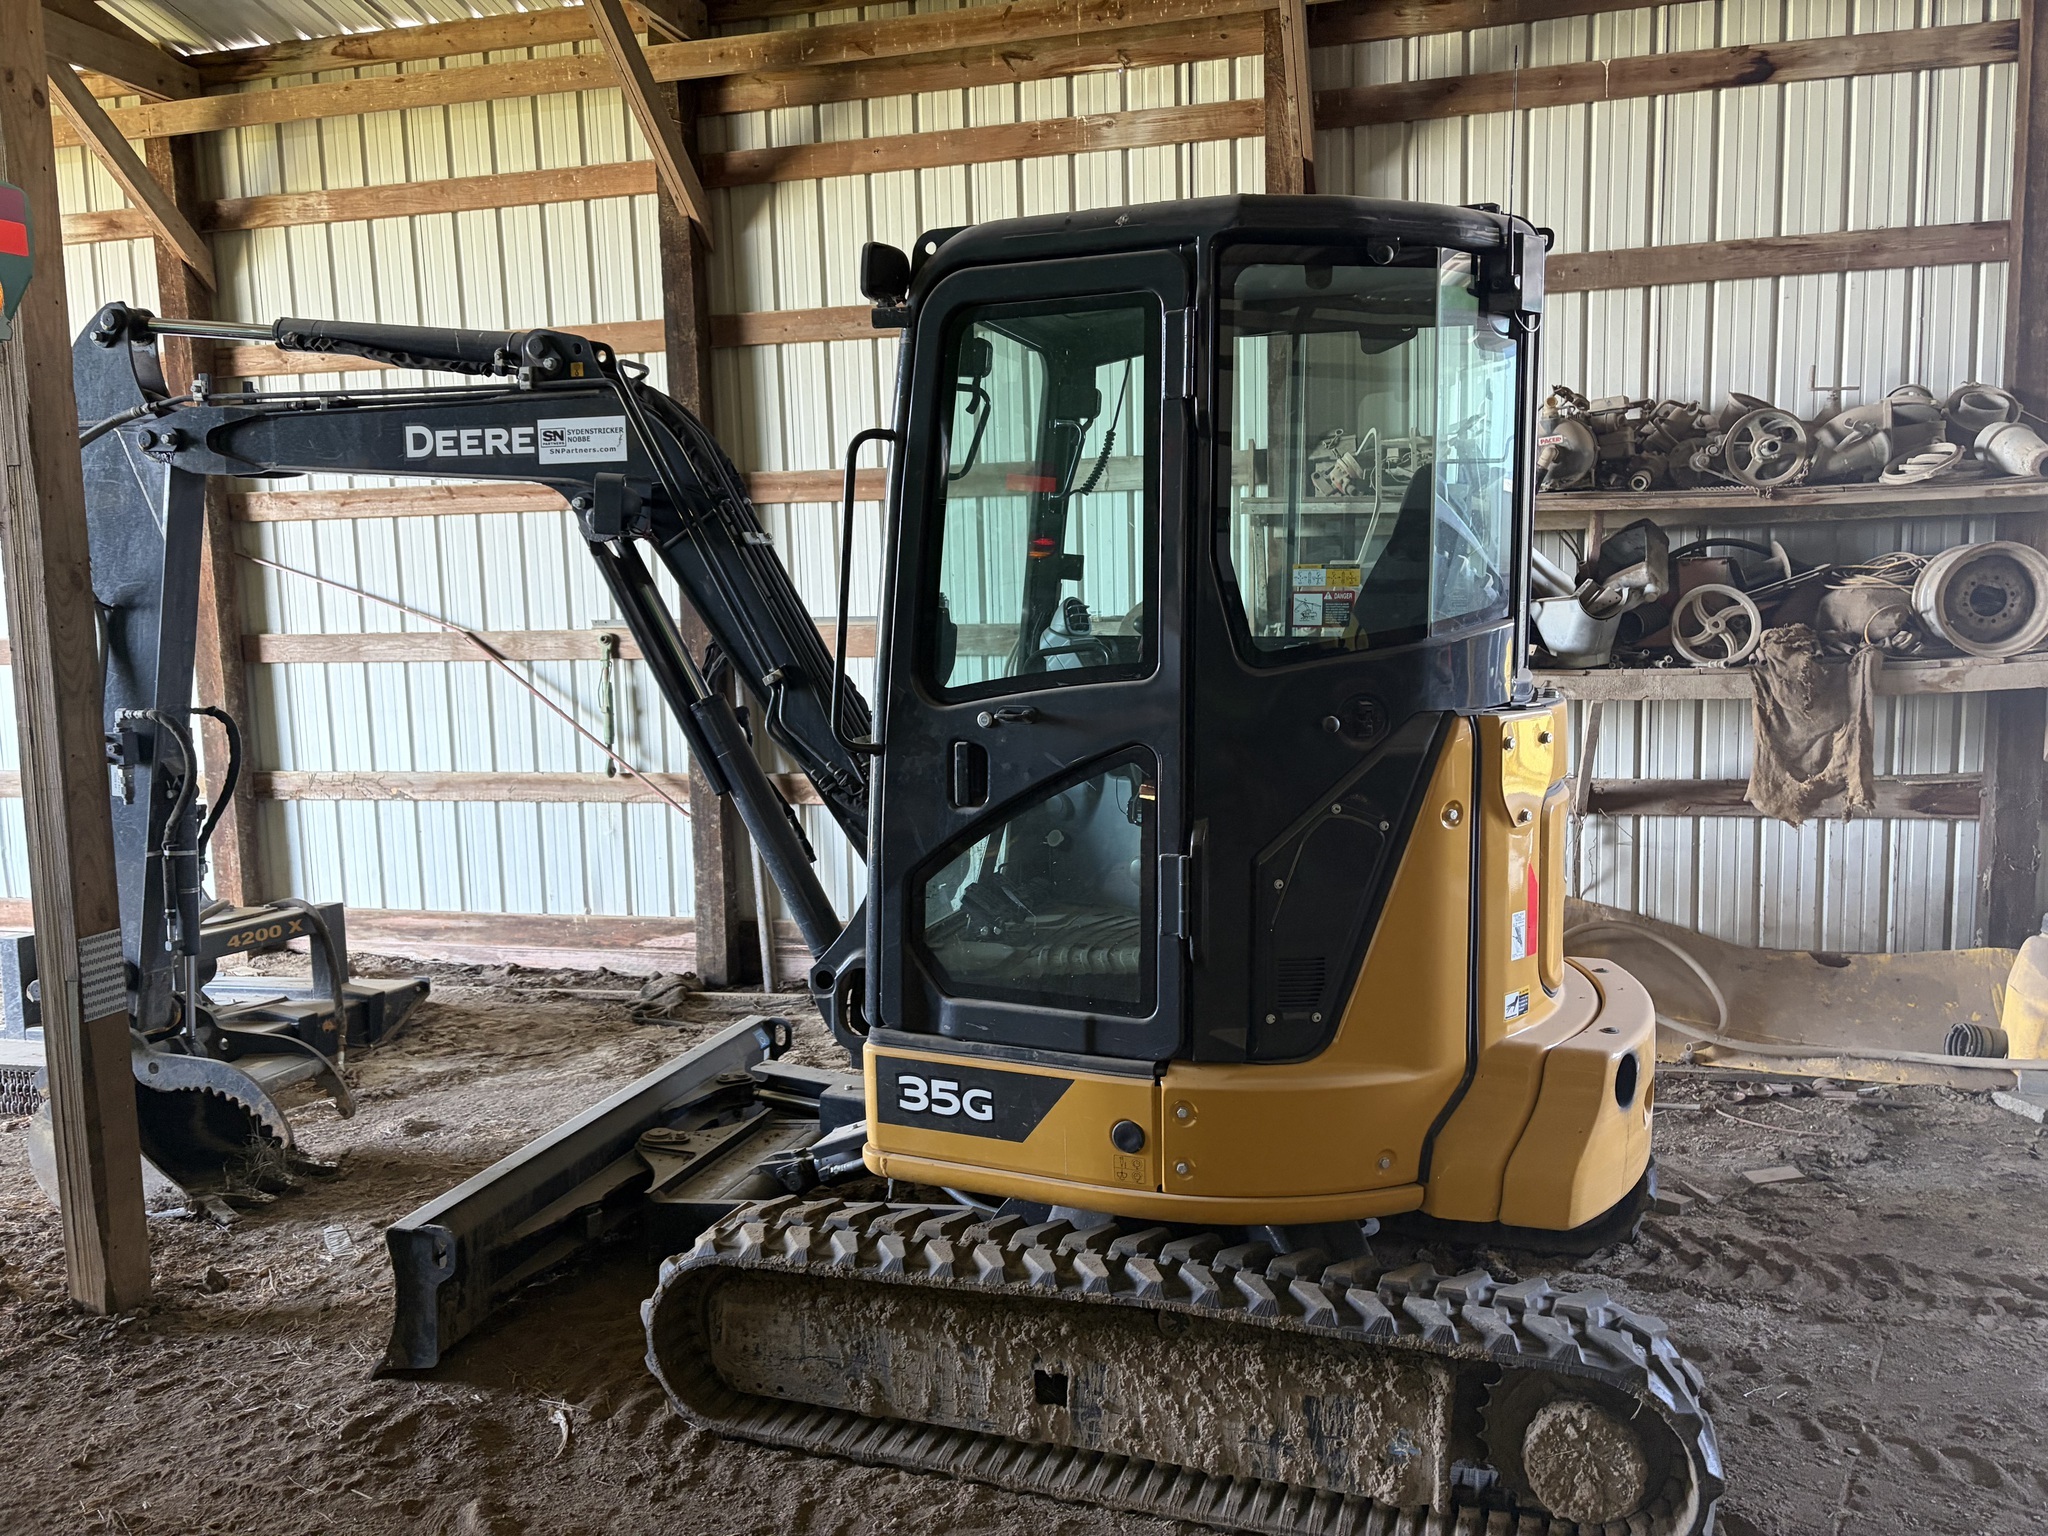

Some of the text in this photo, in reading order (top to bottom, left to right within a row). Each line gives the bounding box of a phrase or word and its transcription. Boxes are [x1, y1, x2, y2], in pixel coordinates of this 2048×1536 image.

[566, 426, 624, 436] SYDENSTRICKER
[405, 425, 536, 458] DEERE
[549, 446, 617, 454] SNPartners.com
[1333, 592, 1353, 600] DANGER
[226, 919, 303, 948] 4200 X
[898, 1074, 993, 1121] 35G
